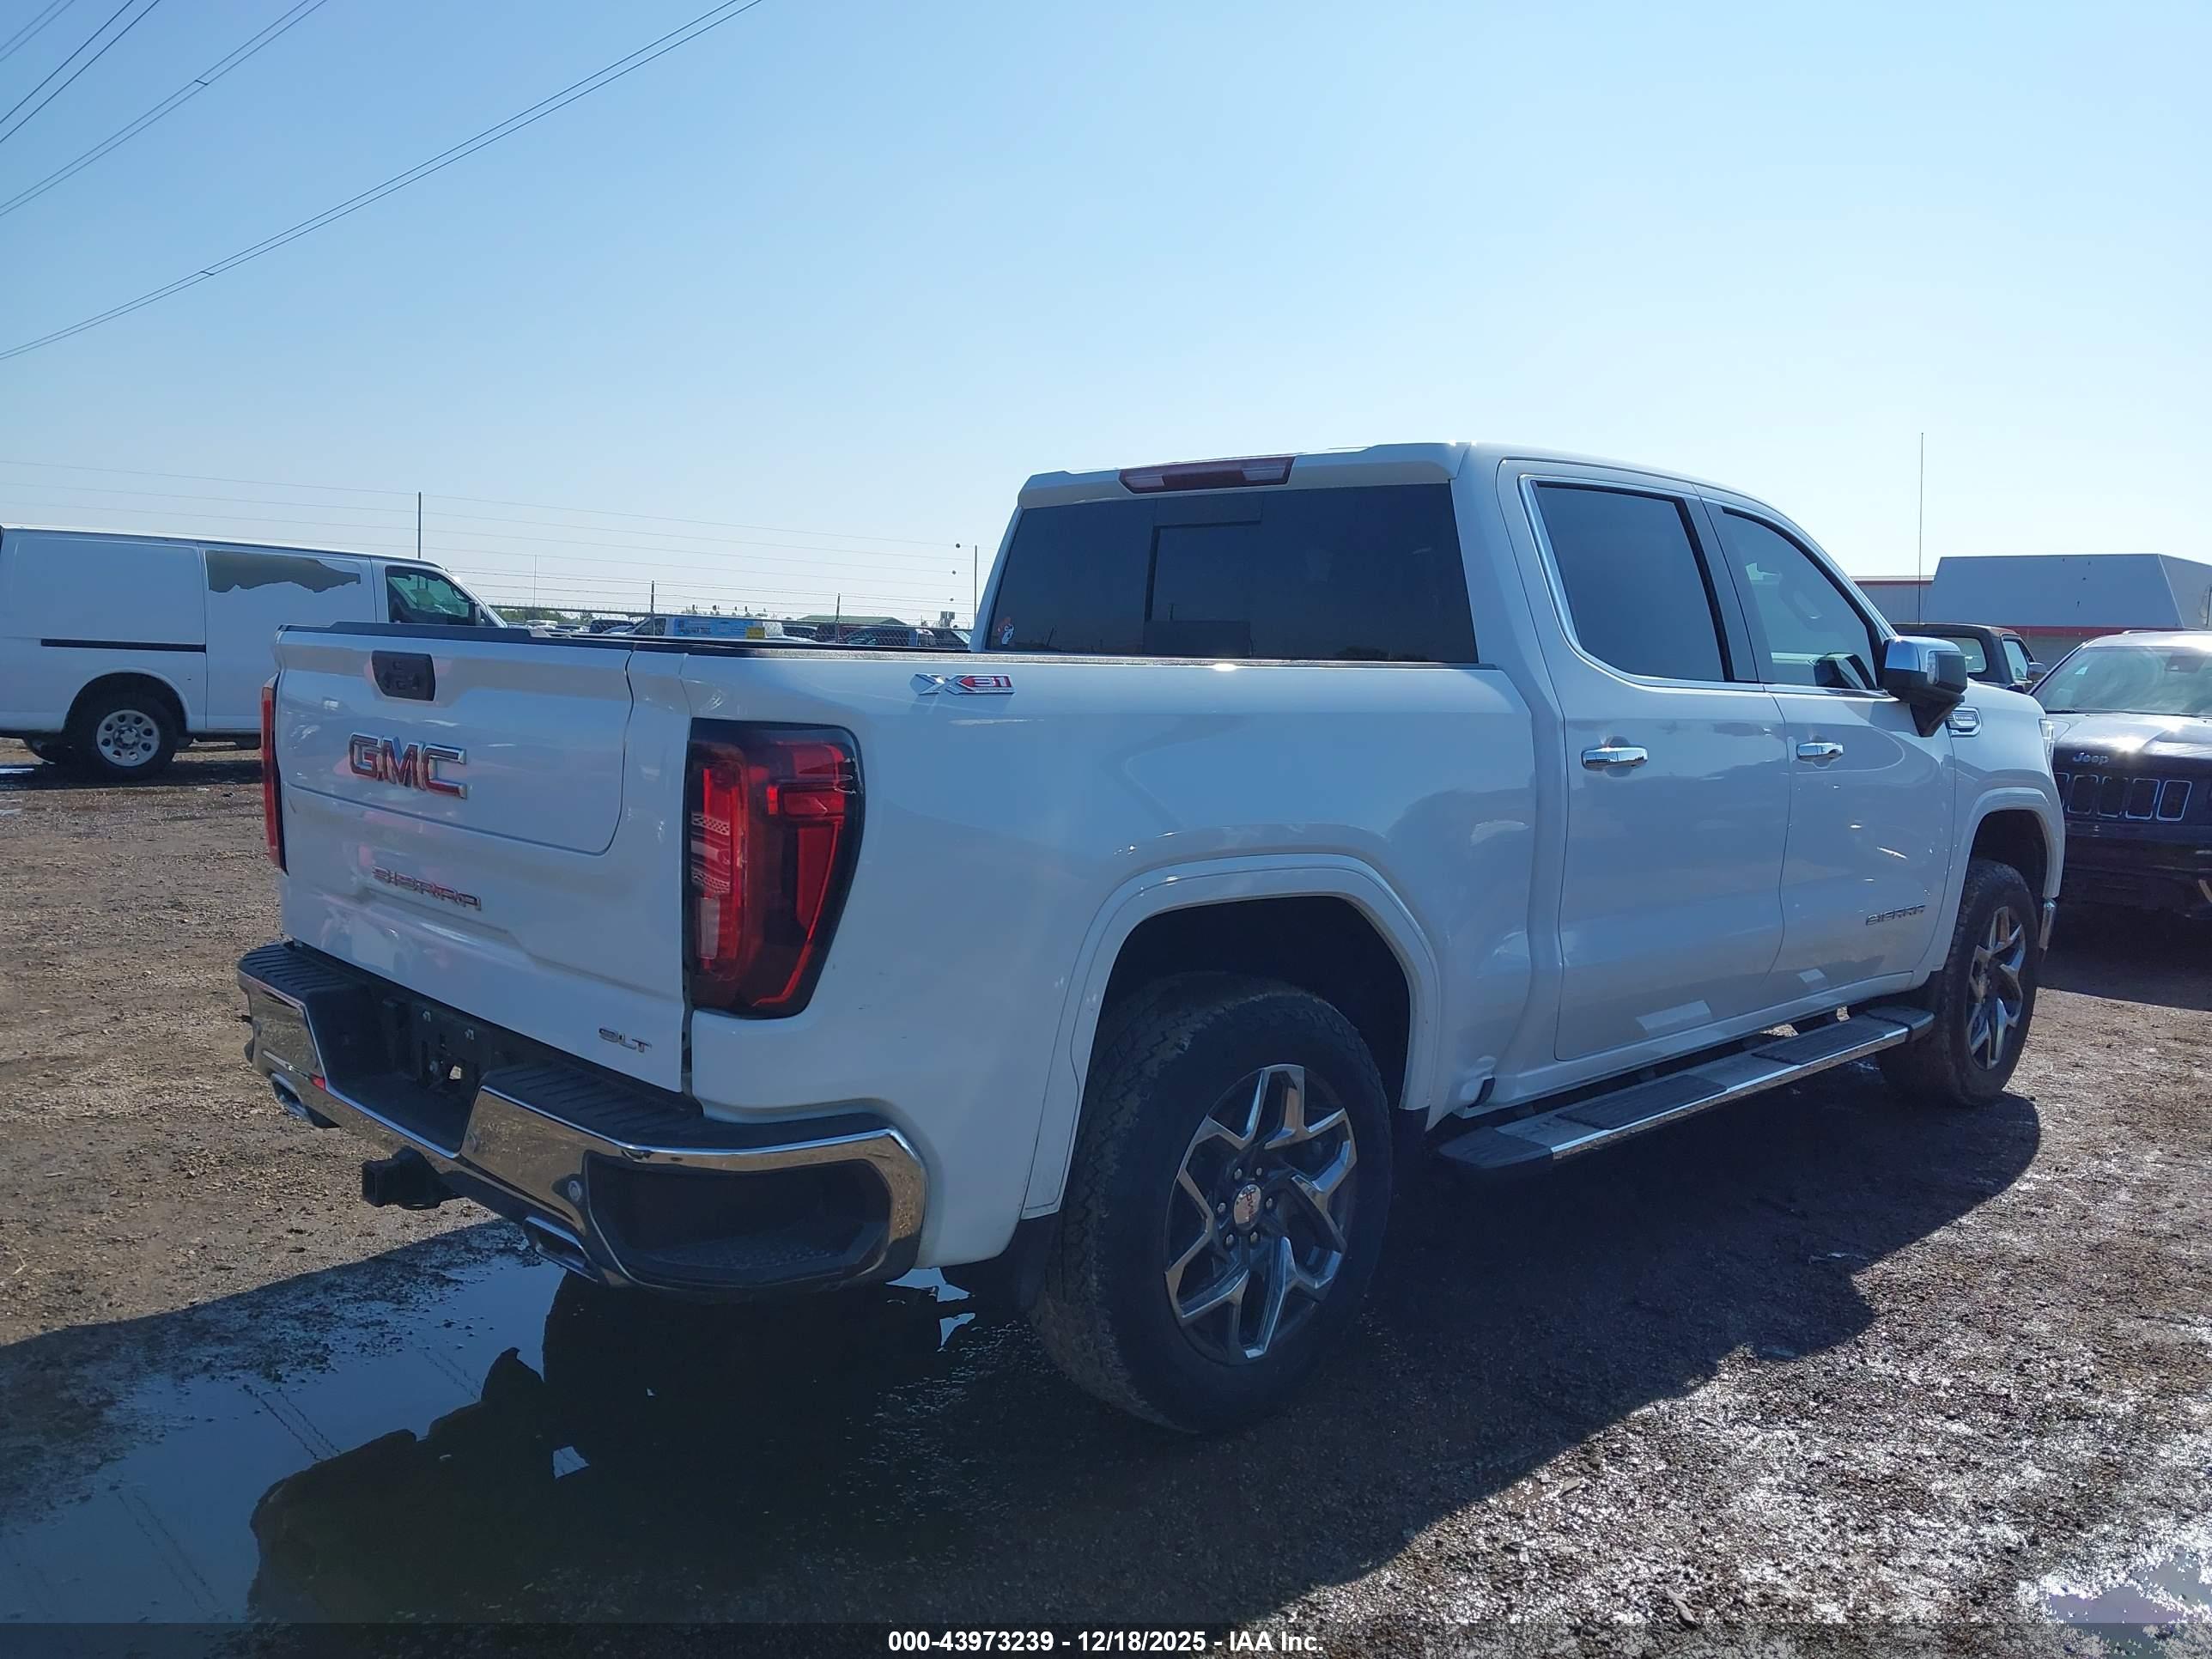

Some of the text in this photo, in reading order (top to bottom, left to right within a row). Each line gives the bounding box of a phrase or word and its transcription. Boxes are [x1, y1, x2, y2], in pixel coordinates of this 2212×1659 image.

[349, 732, 468, 800] GMC
[2073, 752, 2109, 765] Jeep
[372, 866, 482, 911] SIERRA
[599, 1027, 652, 1053] SLT
